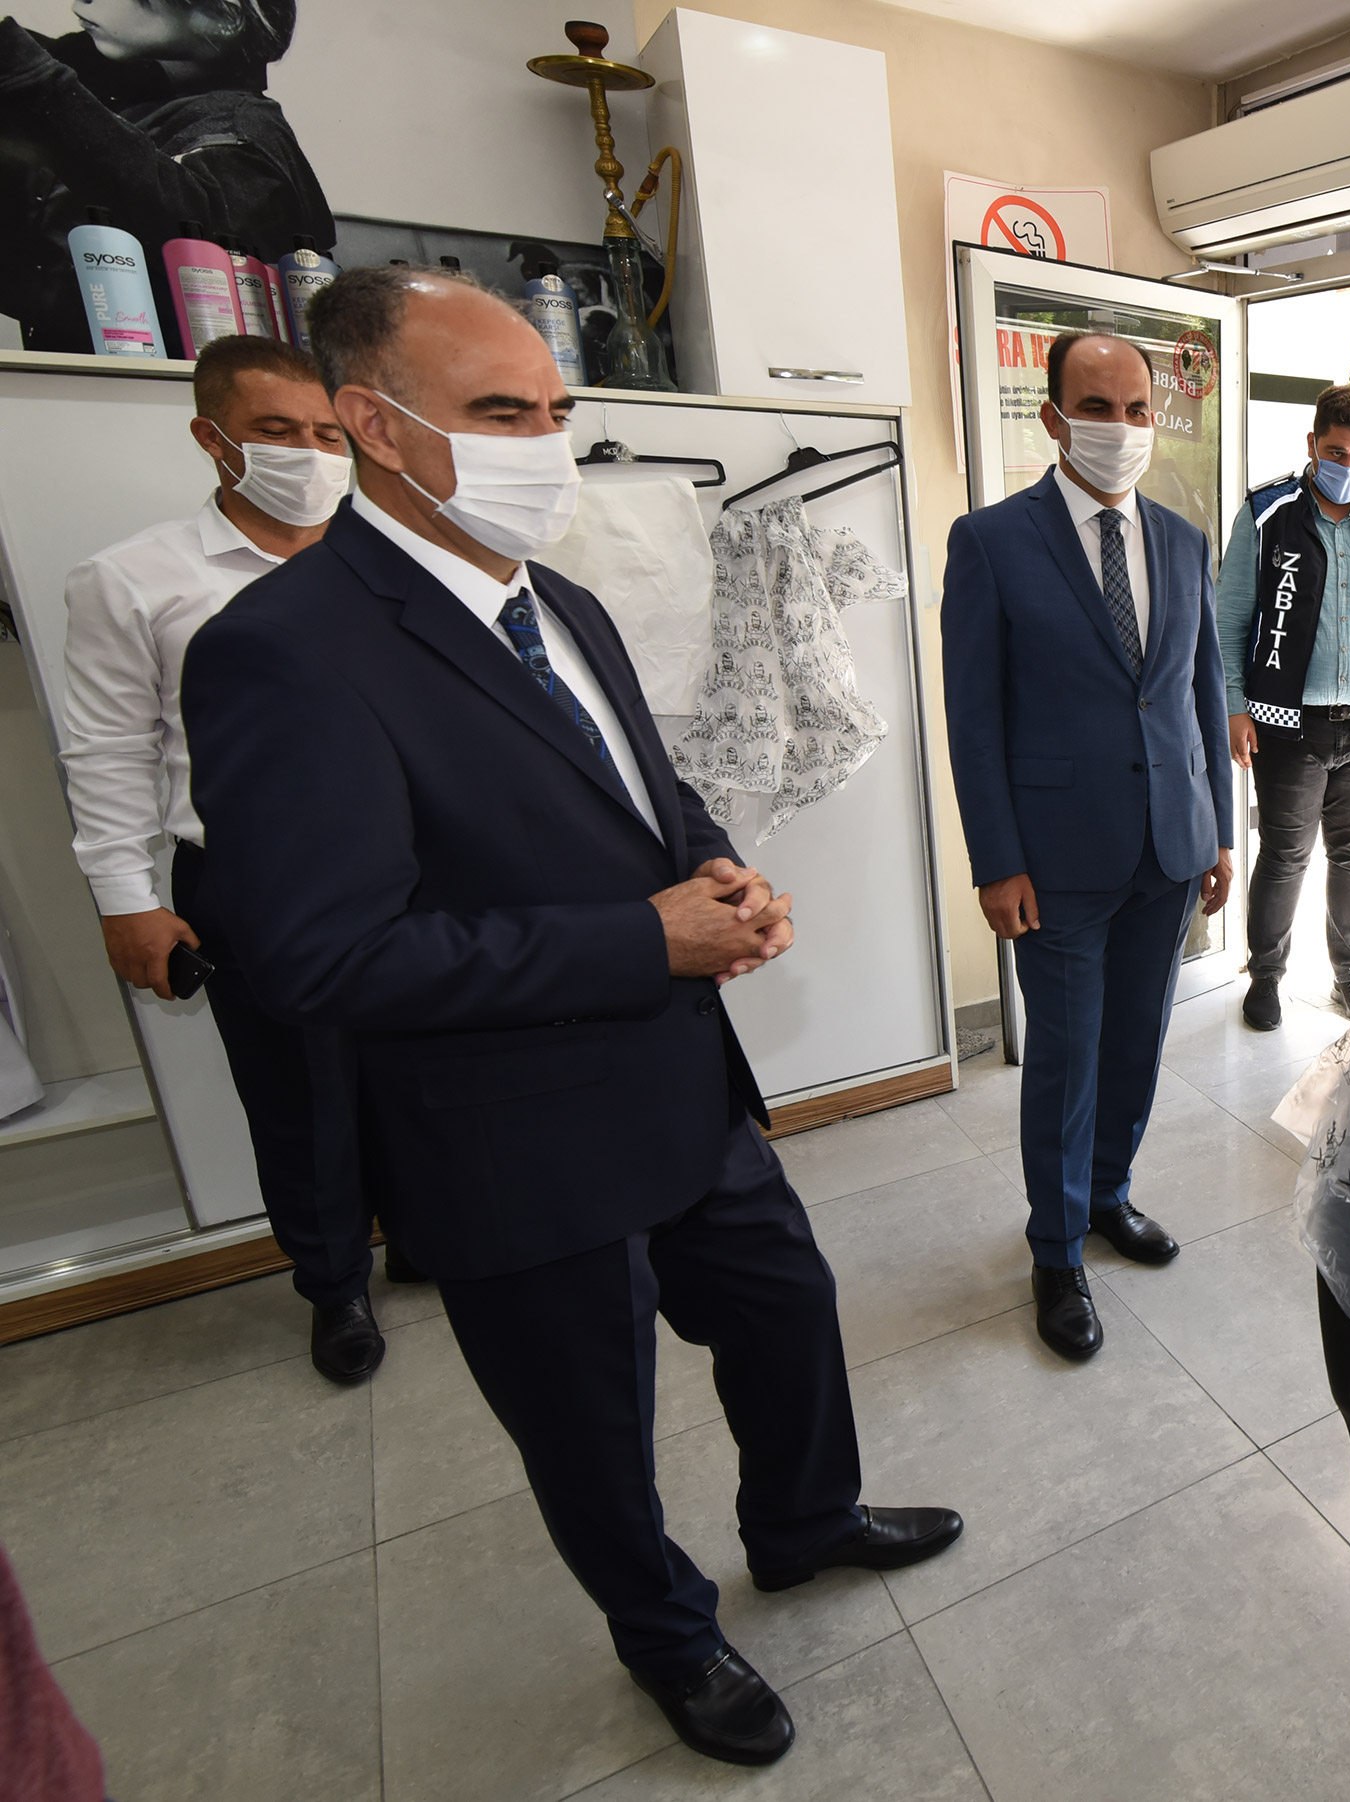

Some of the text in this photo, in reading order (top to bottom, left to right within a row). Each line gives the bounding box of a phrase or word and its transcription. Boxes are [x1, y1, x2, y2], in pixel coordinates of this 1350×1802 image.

[83, 252, 136, 266] syoss
[235, 277, 262, 288] oss
[288, 275, 333, 287] syoss
[90, 283, 112, 321] PURE
[535, 298, 573, 310] syoss
[1266, 551, 1301, 670] ZABITA
